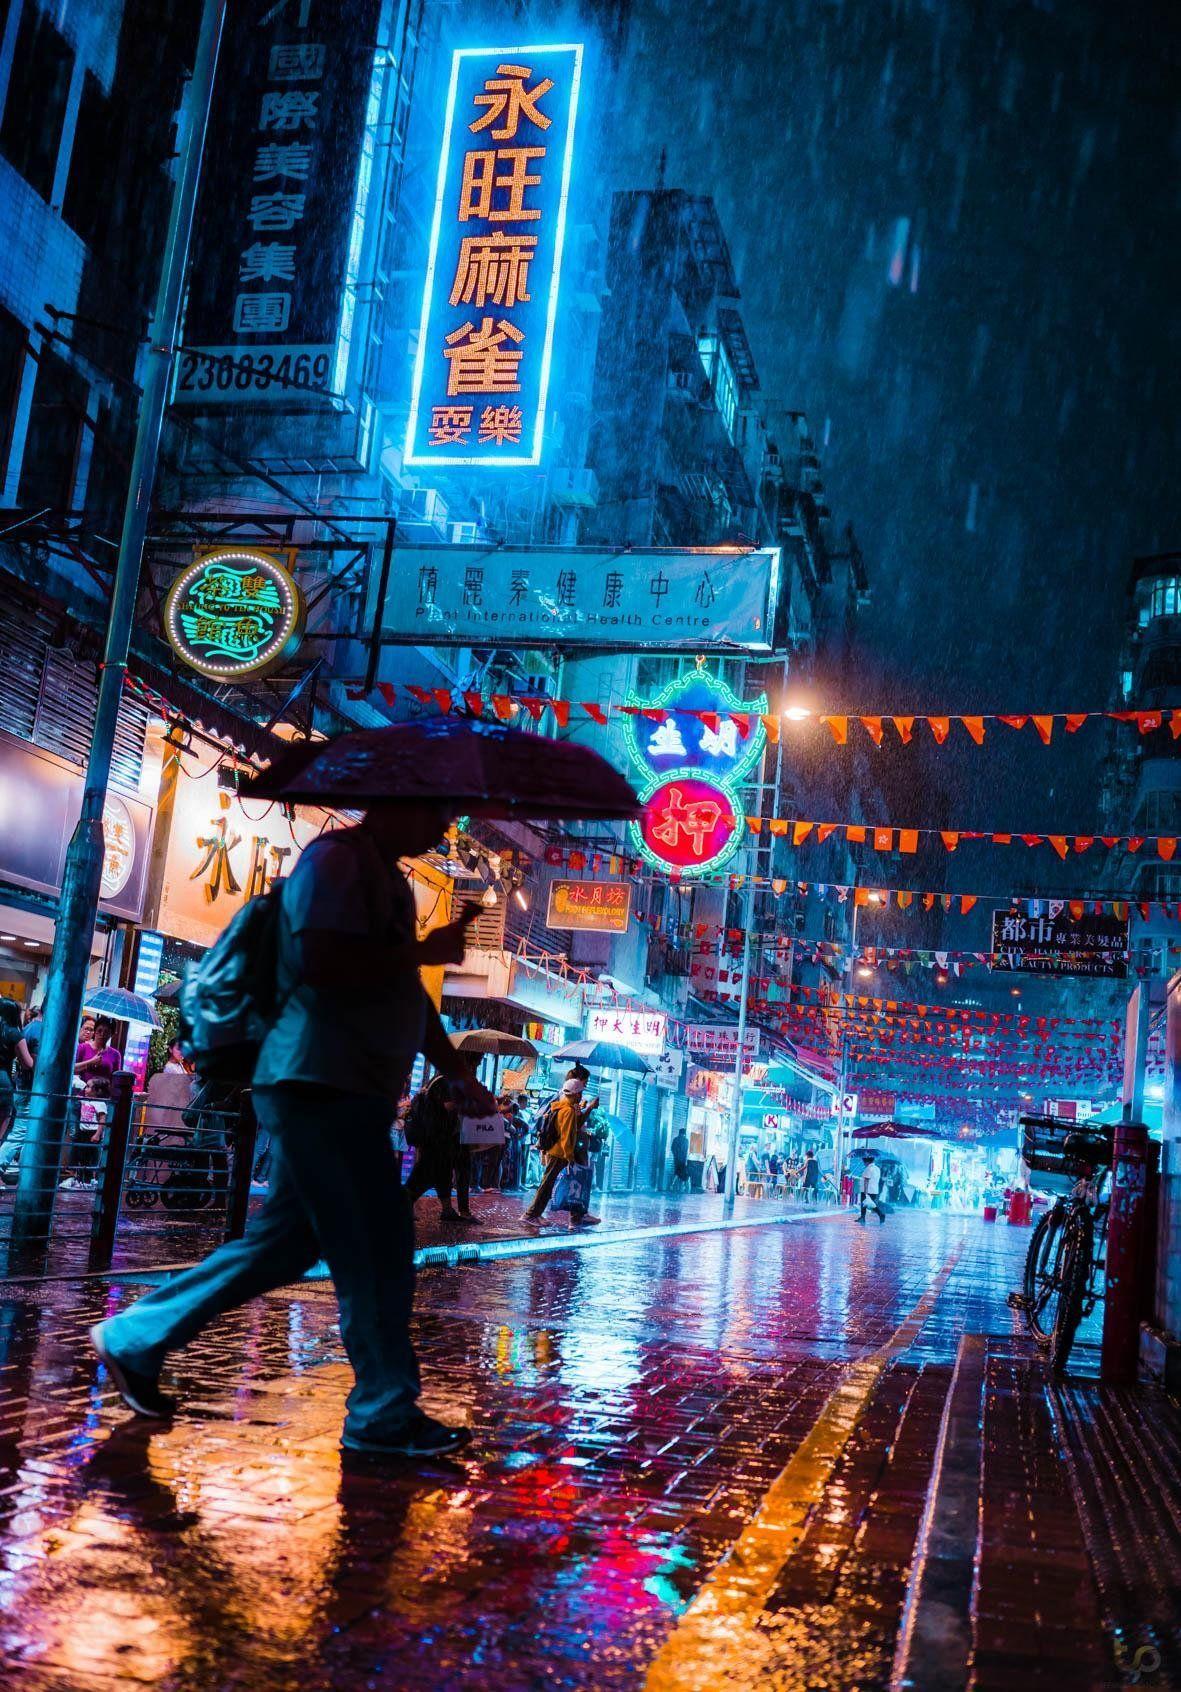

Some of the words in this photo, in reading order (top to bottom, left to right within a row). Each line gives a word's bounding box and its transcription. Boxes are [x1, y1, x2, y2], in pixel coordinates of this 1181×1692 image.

[231, 0, 327, 333] 國際美容集團
[443, 64, 555, 396] 永旺麻雀
[587, 614, 642, 626] Health
[652, 614, 711, 627] Centre
[652, 788, 721, 856] 押
[1001, 916, 1056, 944] 都市
[1060, 961, 1114, 974] PRODUCTS
